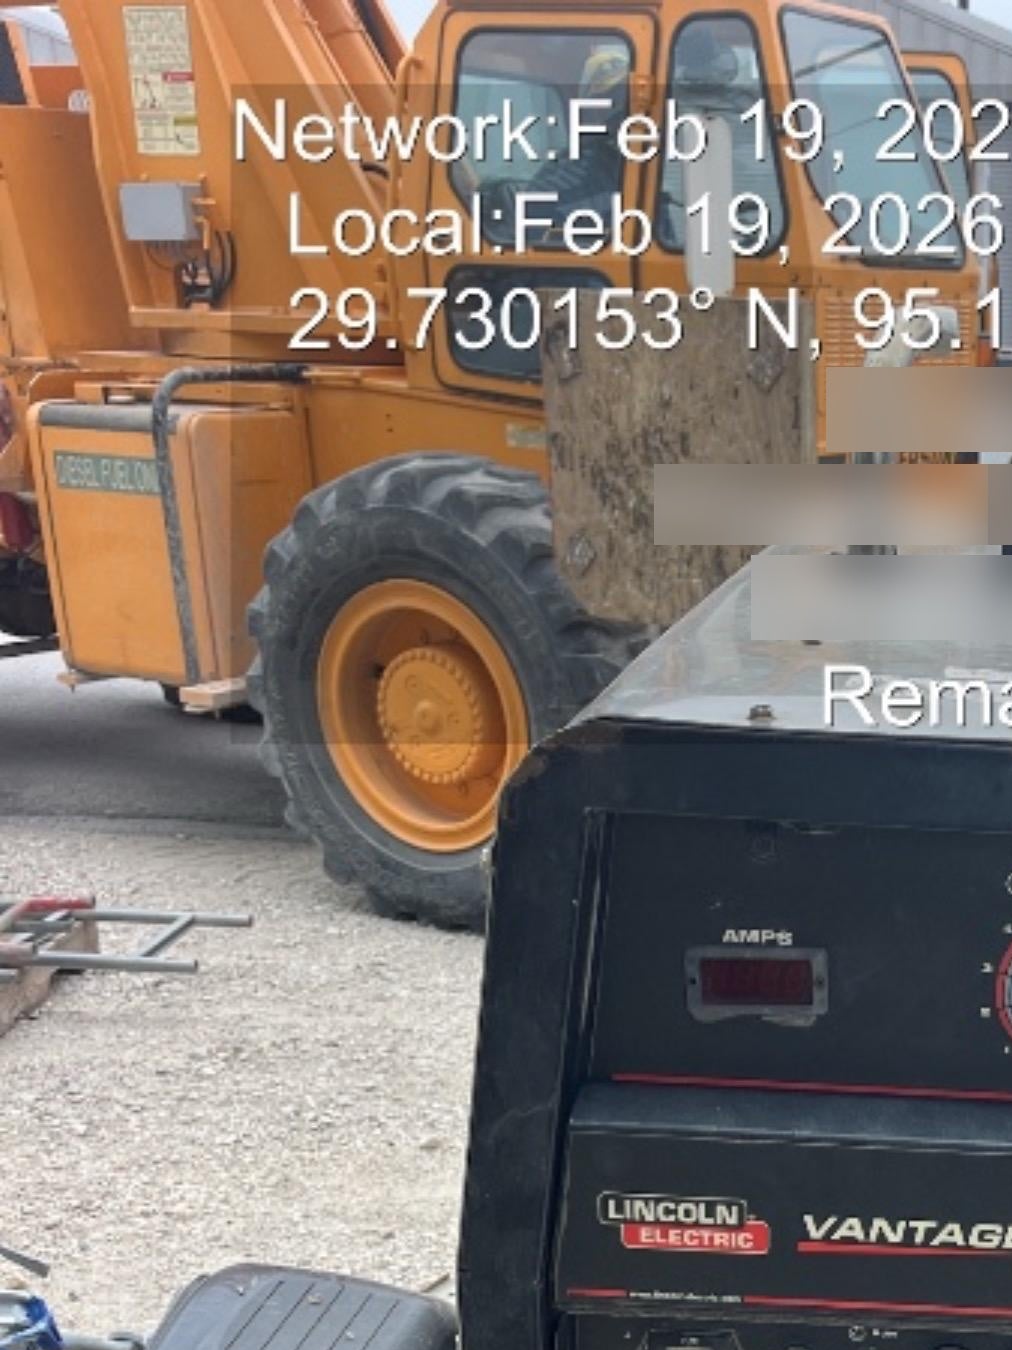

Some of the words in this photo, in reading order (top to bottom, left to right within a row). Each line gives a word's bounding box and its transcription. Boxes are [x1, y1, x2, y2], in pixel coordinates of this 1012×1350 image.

[722, 928, 794, 946] AMPS
[607, 1199, 740, 1226] LINCOLN
[639, 1226, 754, 1249] ELECTRIC
